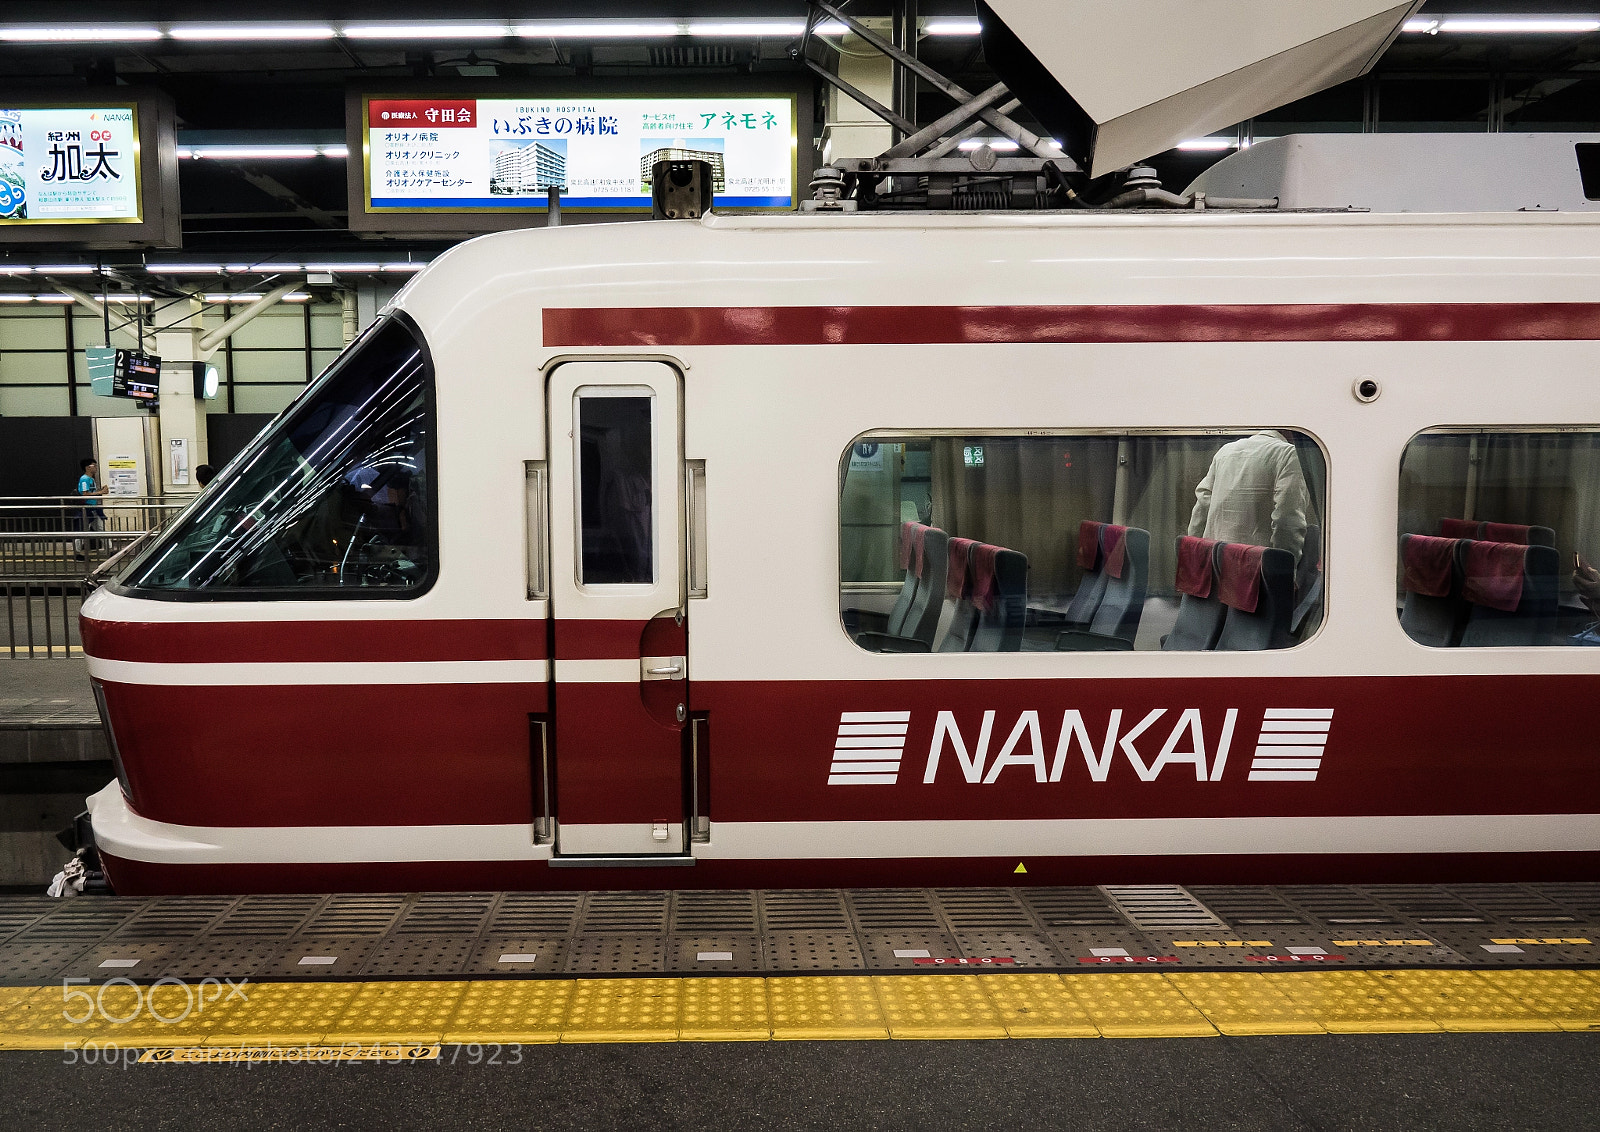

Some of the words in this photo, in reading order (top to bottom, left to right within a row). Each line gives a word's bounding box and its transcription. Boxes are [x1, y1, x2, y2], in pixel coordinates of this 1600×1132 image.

[103, 113, 132, 121] NANKAI
[391, 111, 418, 120] 医療法人
[424, 107, 471, 123] 守田会
[642, 113, 676, 121] サービス付
[493, 115, 619, 135] いぶきの病院
[699, 110, 778, 131] アネモネ
[642, 122, 694, 130] 高齢者向け住宅
[47, 131, 81, 142] 紀州
[91, 131, 111, 141] かだ
[385, 132, 439, 142] オリオノ病院
[385, 150, 460, 160] オリオノクリニック
[40, 142, 121, 181] 加太
[385, 169, 450, 178] 介護老人保健施設
[386, 178, 473, 188] オリオノケアーセンター
[117, 351, 124, 367] 2
[923, 708, 1238, 784] NANKAI
[181, 1048, 400, 1060] ここより内側におさがりください
